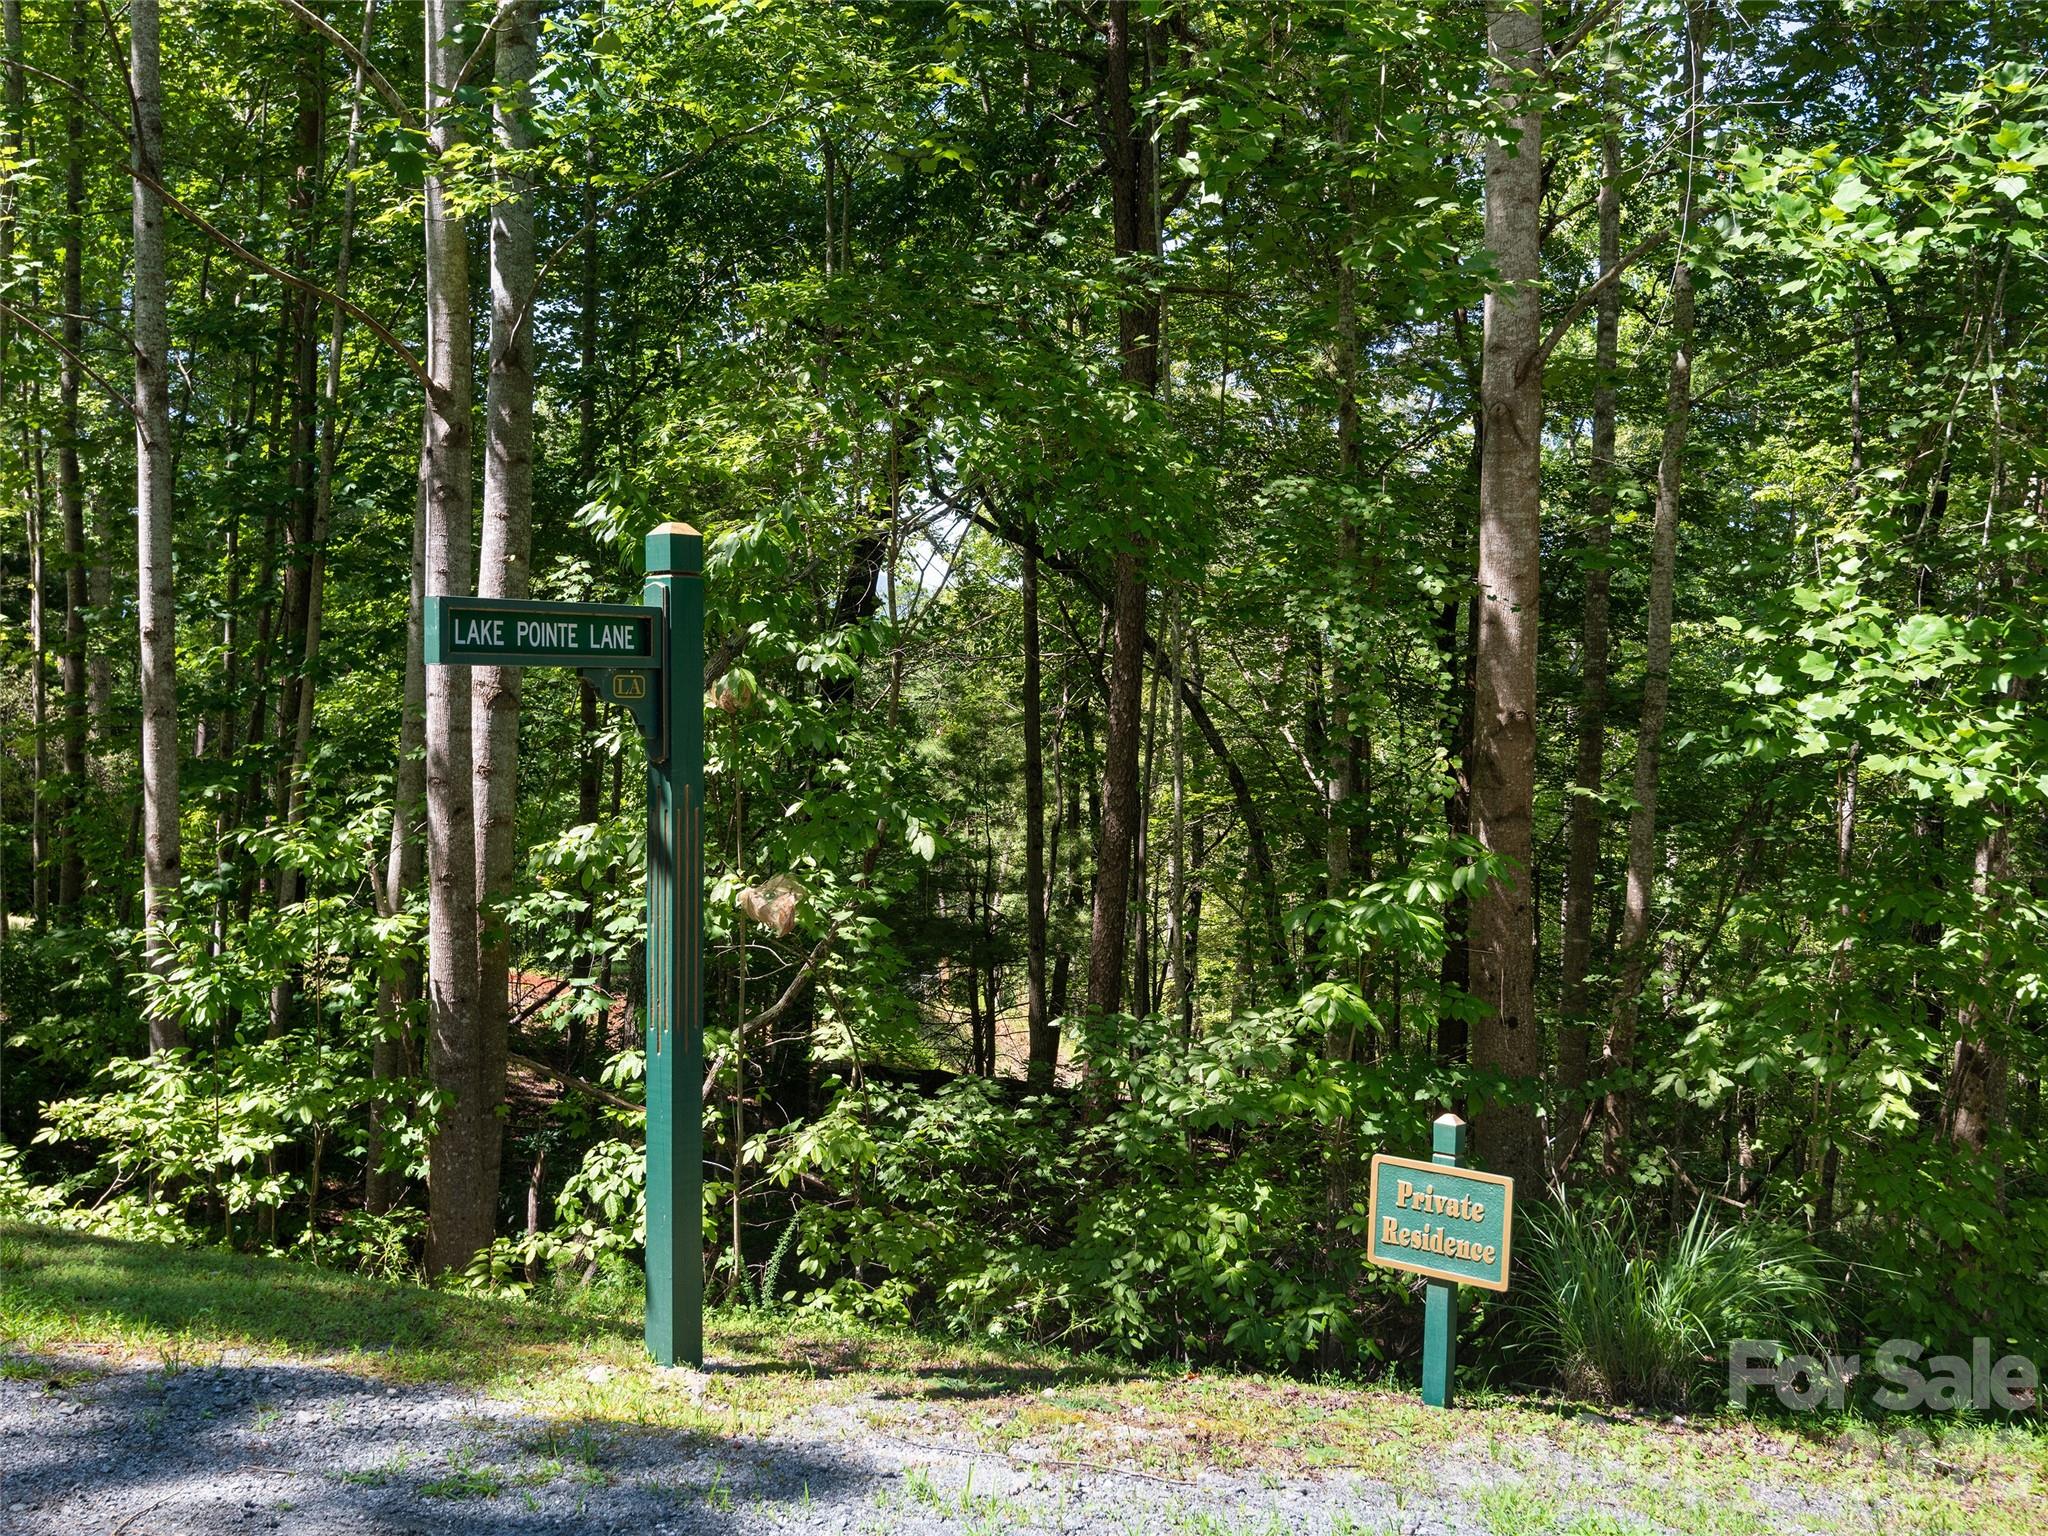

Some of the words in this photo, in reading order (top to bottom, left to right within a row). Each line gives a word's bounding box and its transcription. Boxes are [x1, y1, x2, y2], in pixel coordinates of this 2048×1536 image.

[454, 619, 505, 646] LAKE
[517, 621, 579, 648] POINTE
[590, 624, 635, 650] LANE
[616, 678, 644, 696] LA
[1395, 1179, 1486, 1223] Private
[1381, 1215, 1497, 1265] Residence
